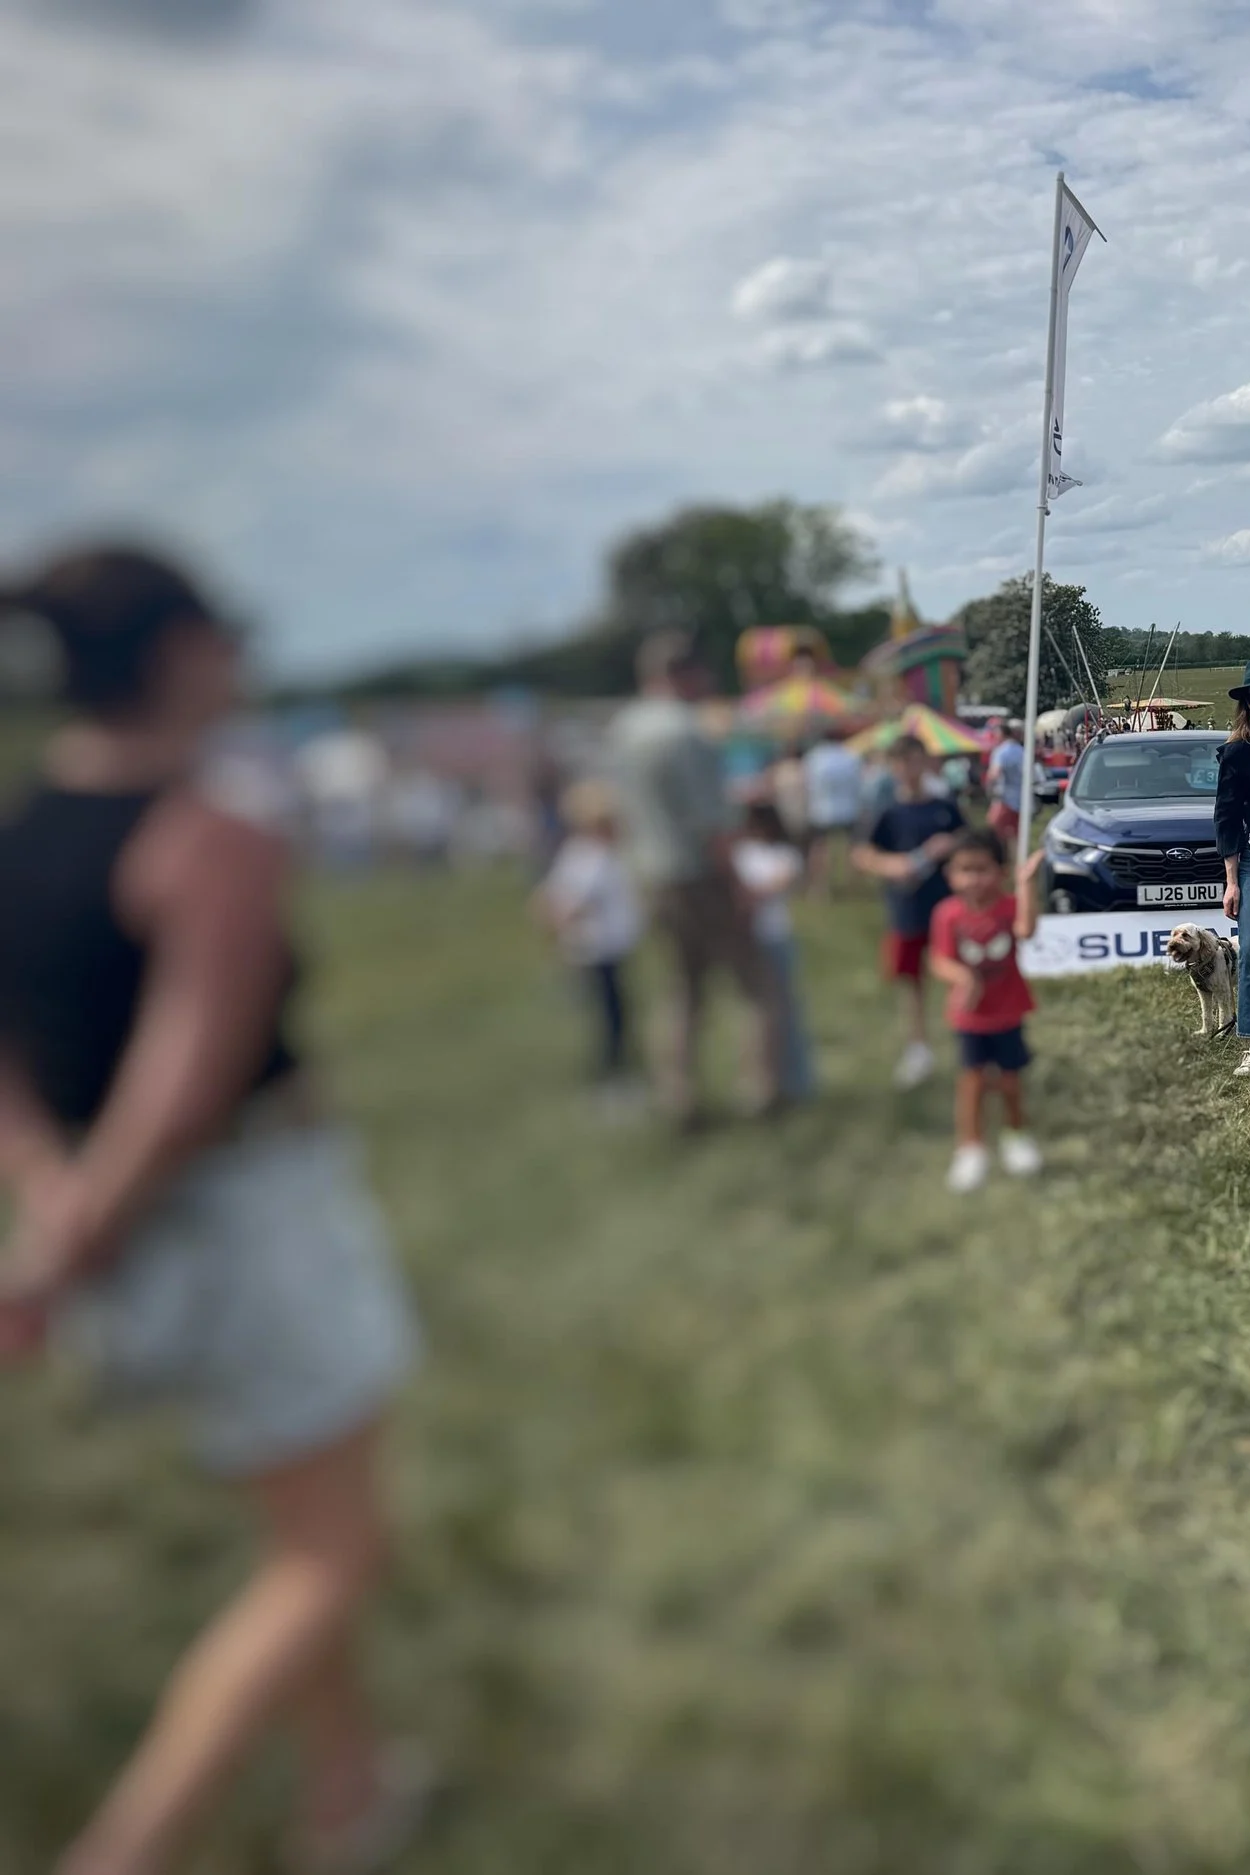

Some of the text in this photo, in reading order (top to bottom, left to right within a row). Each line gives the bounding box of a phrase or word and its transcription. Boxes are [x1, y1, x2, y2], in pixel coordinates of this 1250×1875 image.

[1144, 885, 1217, 901] LJ26 URU
[1079, 927, 1238, 960] SUB
